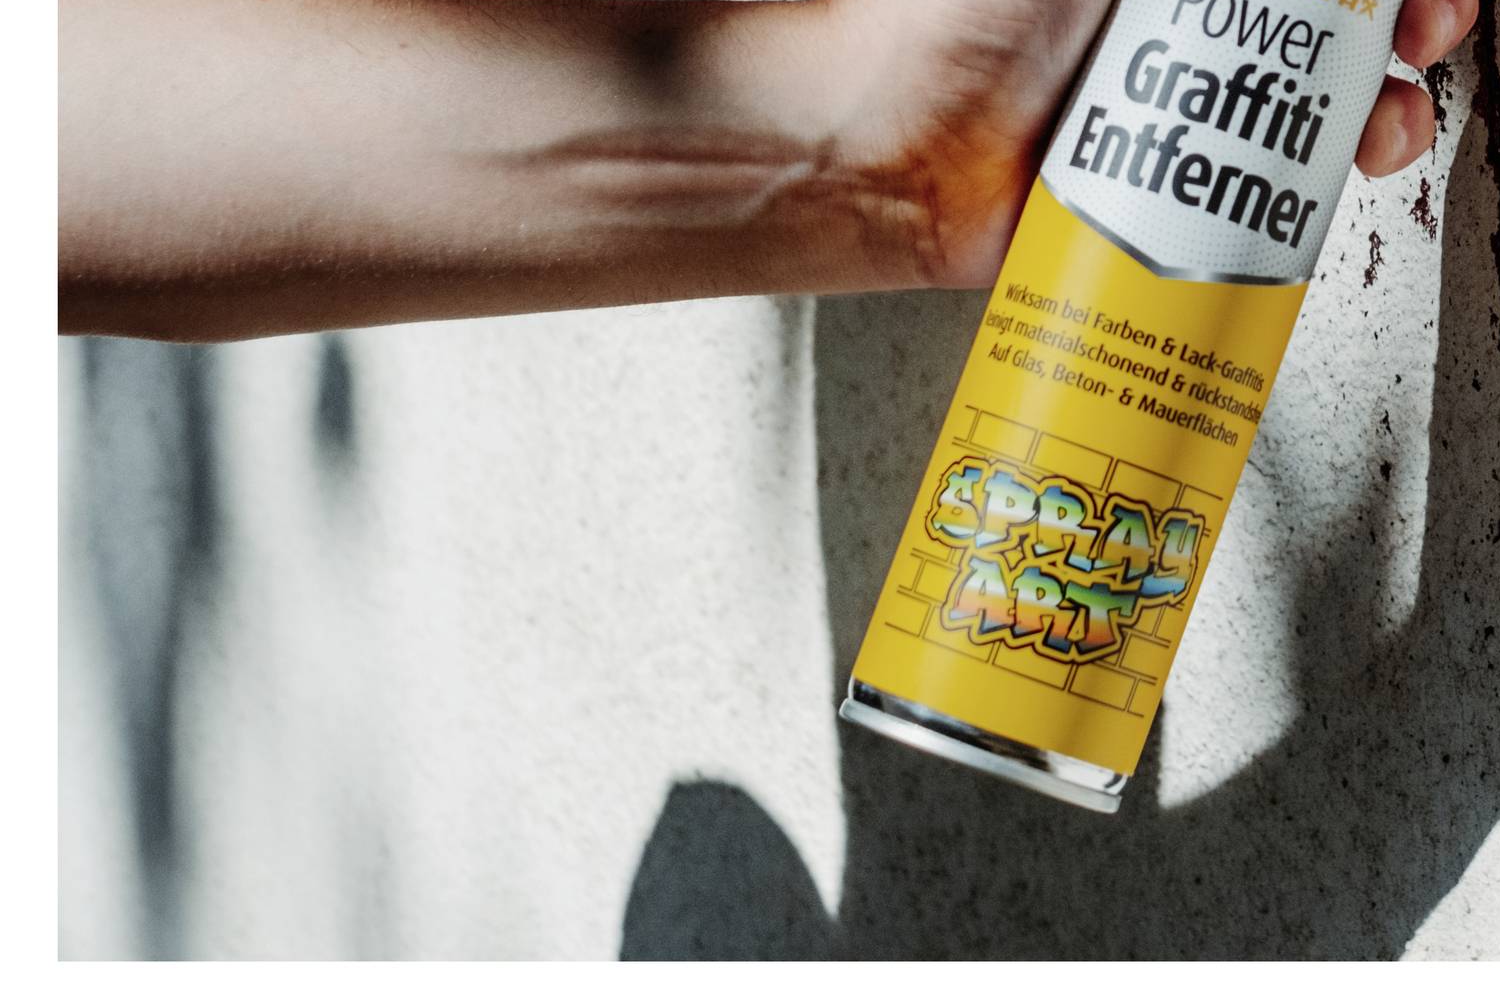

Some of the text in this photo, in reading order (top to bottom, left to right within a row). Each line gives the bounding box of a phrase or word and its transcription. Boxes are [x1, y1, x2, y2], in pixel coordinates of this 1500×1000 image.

[1123, 38, 1331, 166] Graffiti
[1068, 104, 1319, 249] Entferner
[1005, 282, 1058, 315] Wirksam
[1061, 299, 1092, 325] bei
[1092, 311, 1158, 350] Farben
[1160, 336, 1177, 357] &
[1013, 320, 1171, 387] materialschonend
[1170, 372, 1187, 394] &
[987, 341, 1239, 448] Auf Glas, Beton- & Mauerflächen
[930, 463, 1202, 600] SPRAY
[946, 555, 1139, 657] ART
